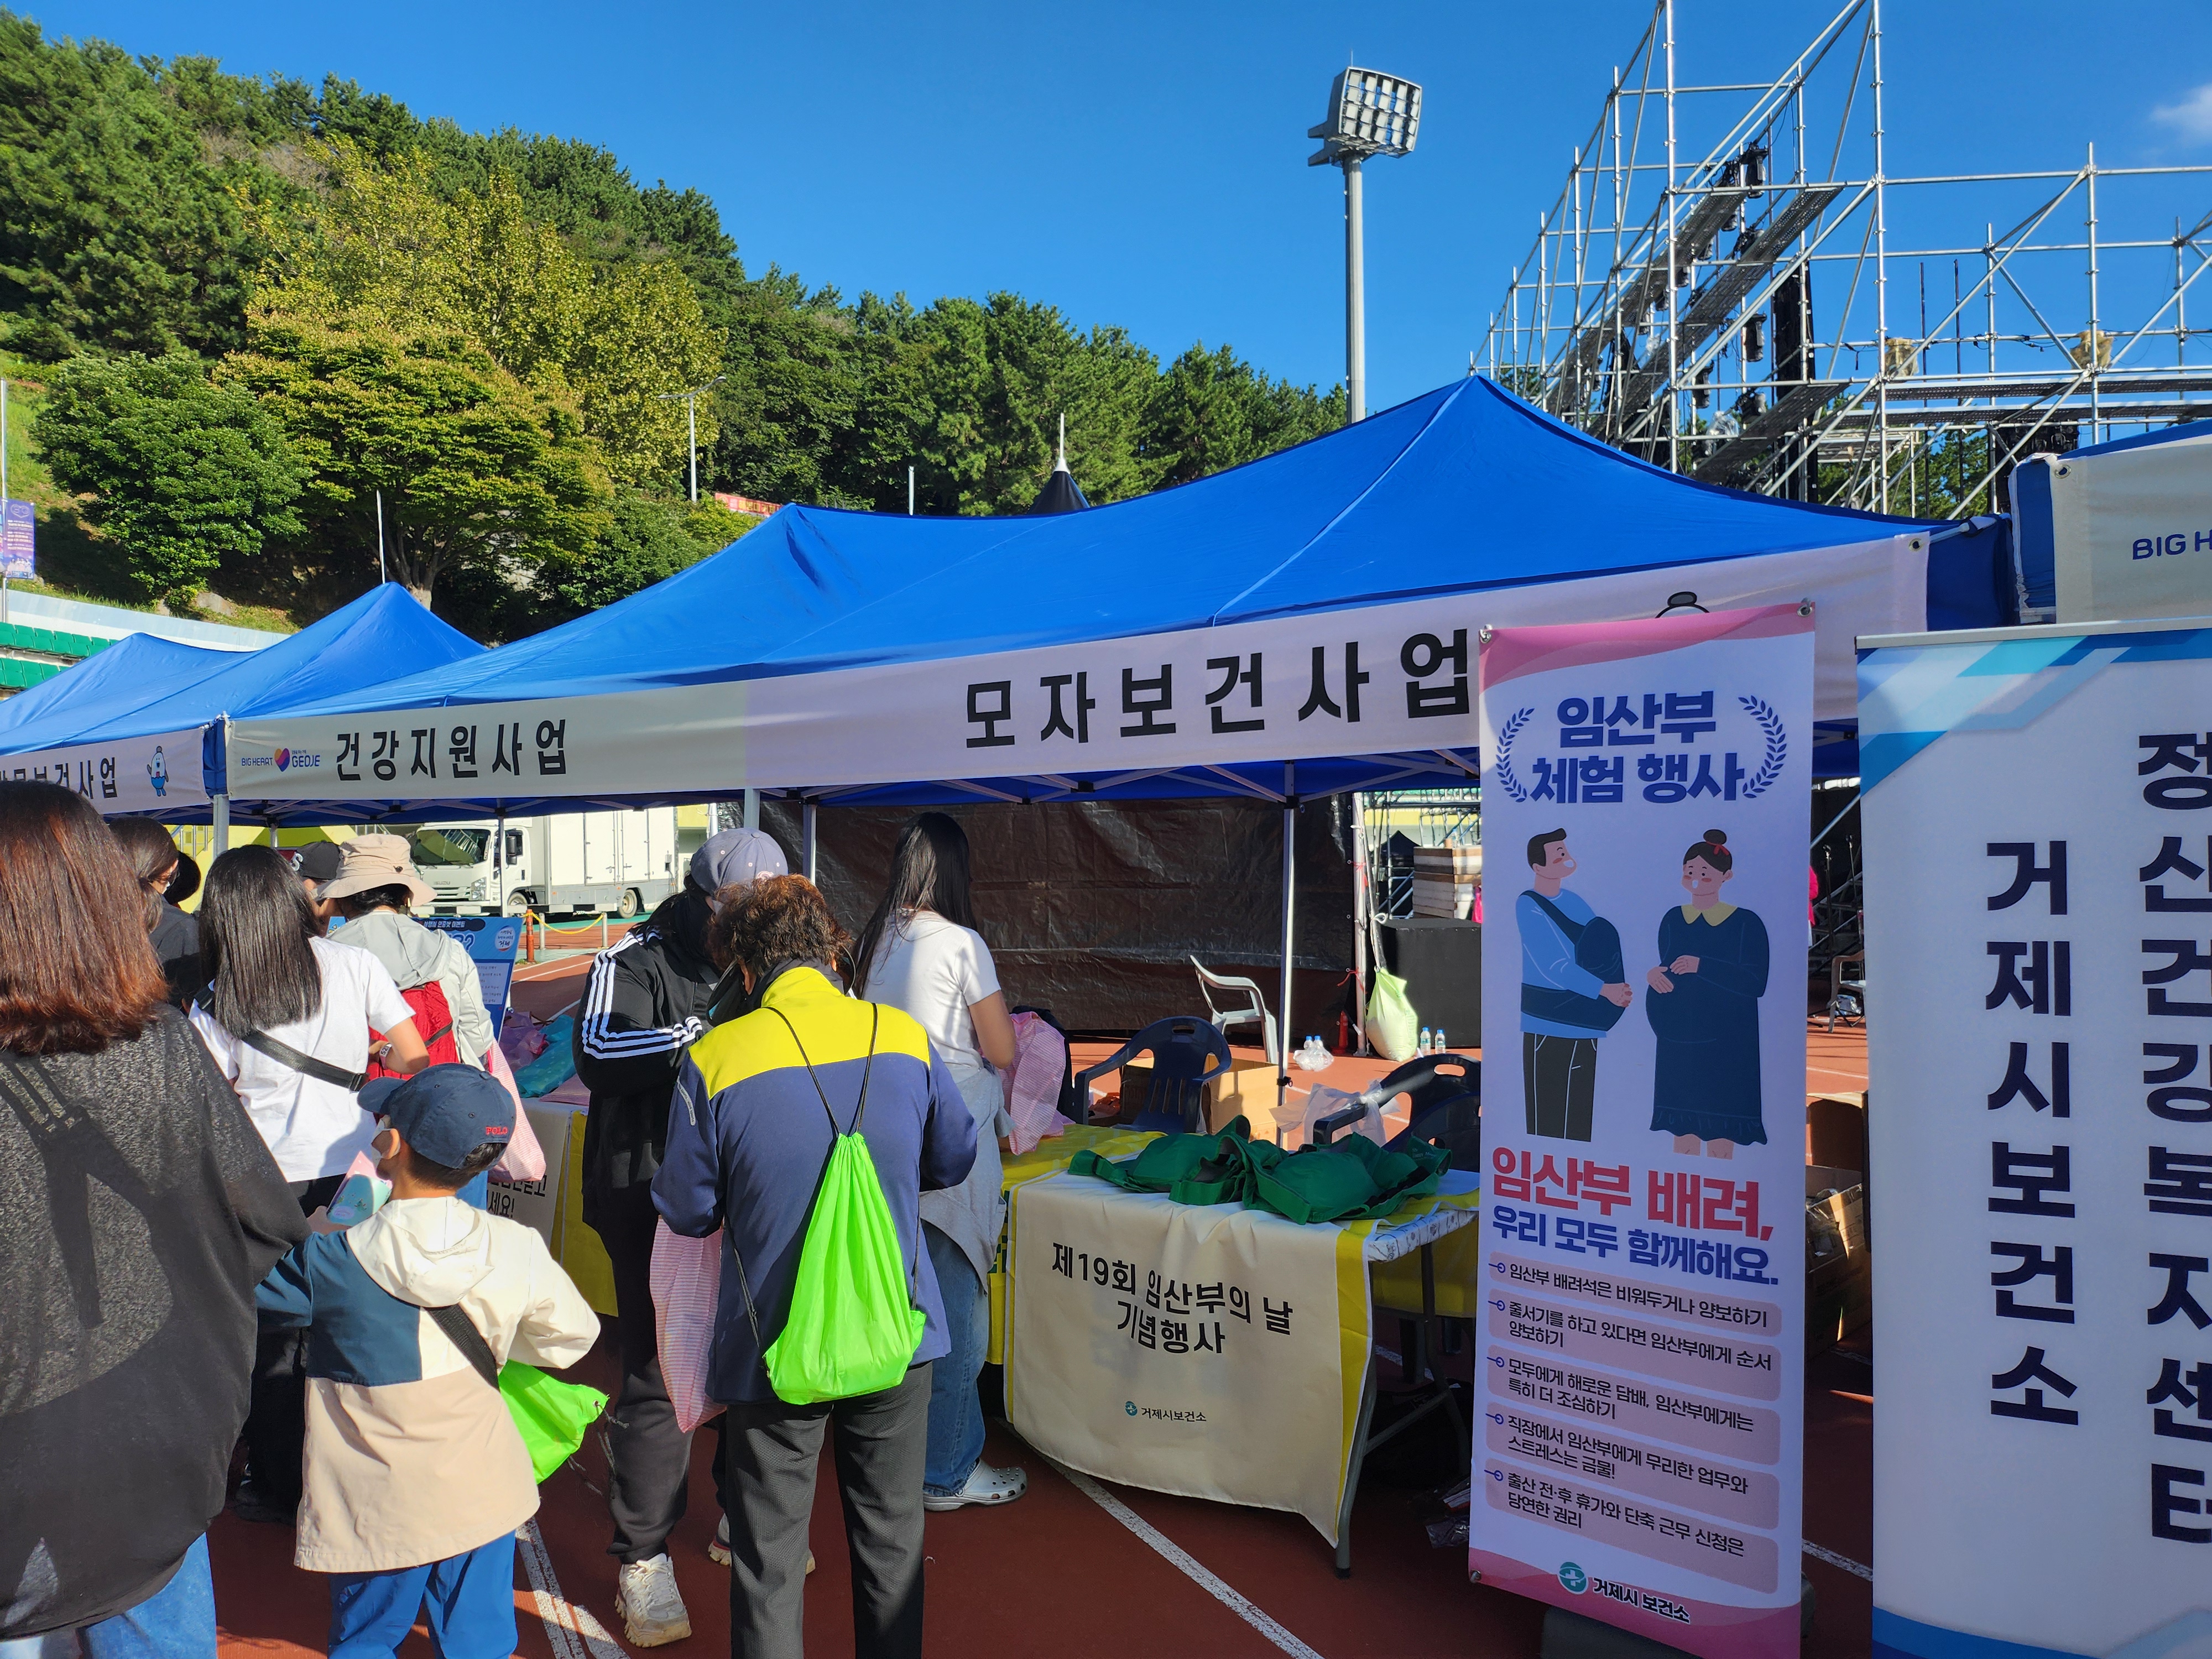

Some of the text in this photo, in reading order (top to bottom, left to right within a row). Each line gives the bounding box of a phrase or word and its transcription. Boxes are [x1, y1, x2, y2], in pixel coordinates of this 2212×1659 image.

[2132, 534, 2186, 560] BIG
[966, 628, 1470, 748] 모자보건사업
[1557, 690, 1716, 748] 임산부
[242, 757, 273, 766] BIG HEART
[292, 755, 320, 768] GEOJE
[336, 719, 566, 781] 건강지원사업
[1530, 753, 1745, 804] 체험 행사
[486, 1126, 508, 1135] POLO
[1986, 841, 2079, 1426] 거제시보건소
[487, 1190, 515, 1218] 세요!
[1493, 1147, 1774, 1241] 임산부 배려,
[1493, 1206, 1778, 1285] 우리 모두 함께해요.
[1052, 1242, 1293, 1336] 제19회 임산부의 날
[1510, 1264, 1767, 1328] 임산부 배려석은 비워두거나 양보하기
[1117, 1300, 1226, 1354] 기념행사
[1509, 1321, 1564, 1348] 양보하기
[1509, 1301, 1772, 1371] 줄서기를 하고 있다면 임산부에게 순서
[1140, 1407, 1207, 1423] 거제시보건소
[1508, 1377, 1616, 1420] 특히 더 조심하기
[1509, 1358, 1754, 1432] 모두에게 해로운 담배, 임산부에게는
[1507, 1437, 1616, 1480] 스트레스는 금물!
[1508, 1415, 1749, 1494] 직장에서 임산부에게 무리한 업무와
[1507, 1491, 1582, 1528] 당연한 권리
[1507, 1472, 1536, 1494] 출산
[1576, 1493, 1621, 1520] 휴가와
[1625, 1507, 1655, 1530] 단축
[1659, 1517, 1691, 1541] 근무
[1695, 1527, 1744, 1557] 신청은
[1593, 1577, 1691, 1624] 거제시 보건소
